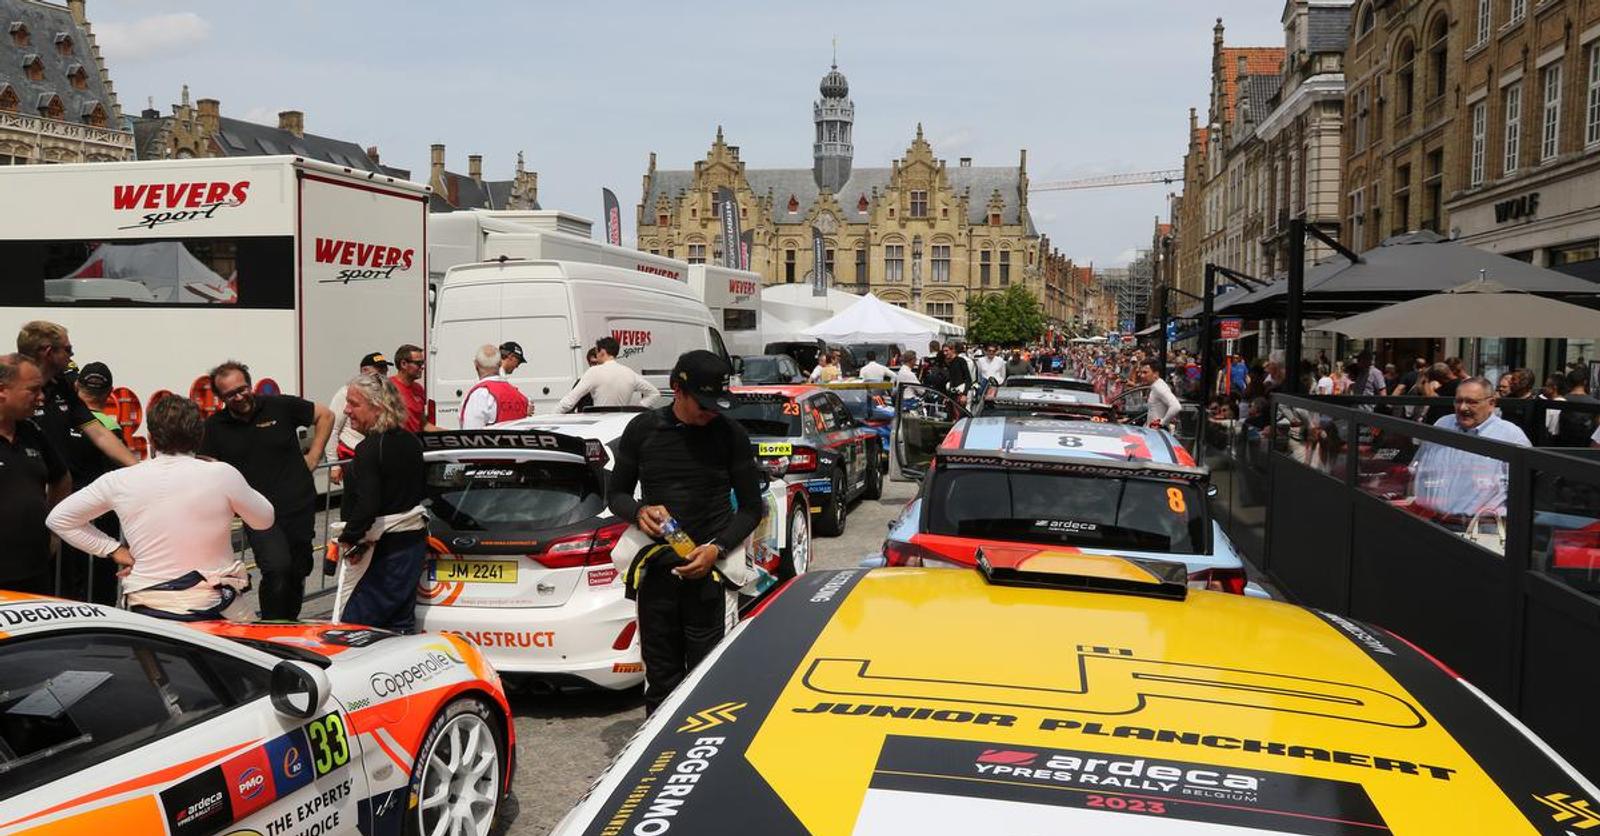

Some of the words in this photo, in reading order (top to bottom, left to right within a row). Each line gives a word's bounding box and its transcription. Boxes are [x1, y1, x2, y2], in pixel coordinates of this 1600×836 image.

[113, 181, 250, 209] WEVERS
[139, 202, 217, 229] sport
[1494, 192, 1541, 224] WOLF
[315, 238, 414, 271] WEVERS
[336, 265, 398, 284] sport
[729, 279, 756, 295] WEVERS
[612, 329, 652, 346] WEVERS
[783, 401, 800, 415] 23
[421, 434, 558, 449] ESMYTER
[760, 446, 791, 456] isorex
[1057, 435, 1083, 448] 8
[945, 455, 1203, 480] www.bma-autosport.com
[1166, 487, 1186, 513] 8
[1050, 521, 1097, 531] ardeca
[448, 564, 468, 579] JM
[473, 565, 503, 579] 2241
[4, 604, 107, 626] Declerck
[440, 630, 556, 648] NSTRUCT
[371, 651, 450, 697] Coppenolle
[309, 713, 350, 776] 33
[415, 713, 446, 779] MICHELIN
[792, 702, 1018, 728] JUNIOR
[1038, 718, 1457, 781] PLANCKAERT
[238, 774, 265, 795] PMO
[975, 763, 1073, 783] YPRES
[1080, 774, 1179, 793] RALLY
[1181, 788, 1259, 803] BELGIUM
[1045, 755, 1259, 790] ardeca
[187, 791, 223, 816] ardeca
[1086, 794, 1167, 816] 2023
[265, 811, 293, 836] THE
